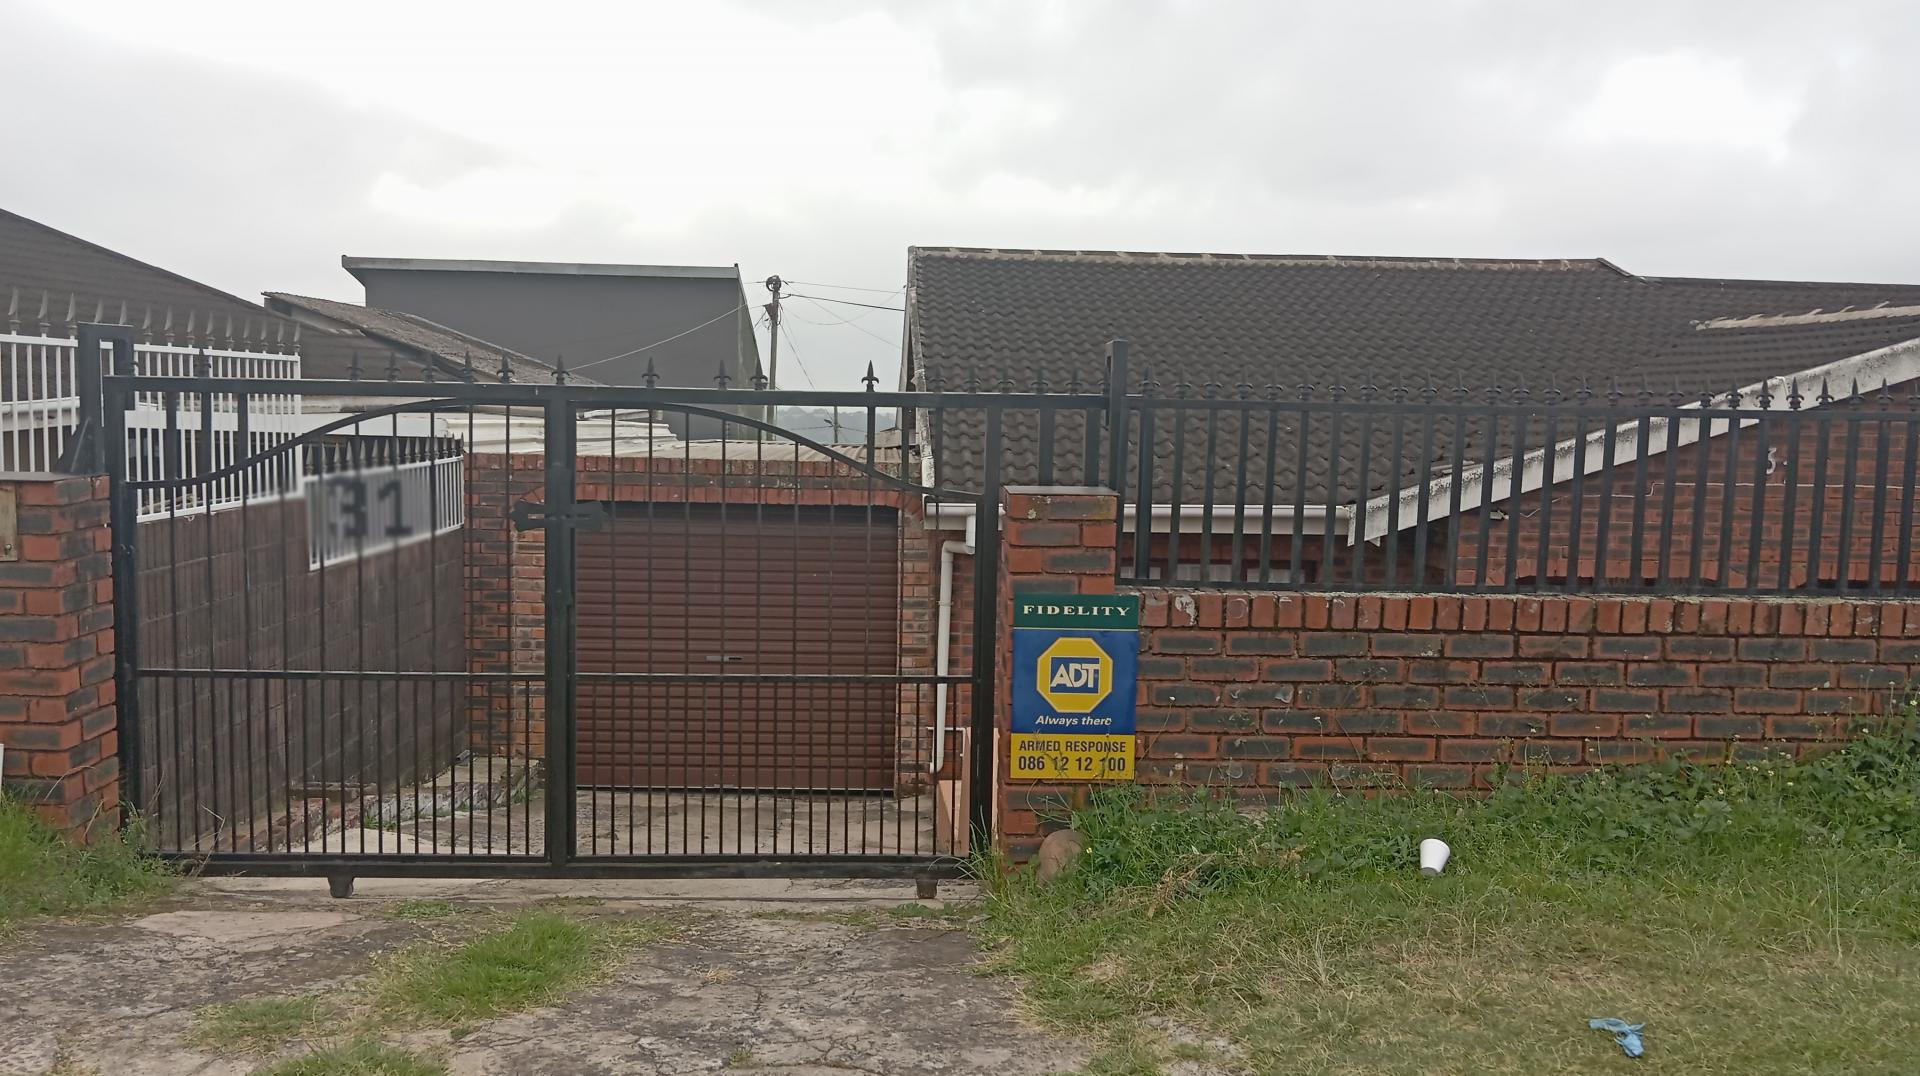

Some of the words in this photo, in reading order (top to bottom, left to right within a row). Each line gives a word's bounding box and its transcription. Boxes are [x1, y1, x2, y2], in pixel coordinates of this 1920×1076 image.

[1023, 605, 1131, 616] FIDELITY
[1050, 663, 1099, 688] ADT
[1035, 715, 1078, 727] Always
[1081, 716, 1112, 726] there
[1019, 740, 1060, 751] ARMED
[1065, 741, 1126, 752] RESPONSE
[1018, 756, 1045, 771] 086
[1053, 756, 1069, 771] 12
[1076, 757, 1092, 771] 12
